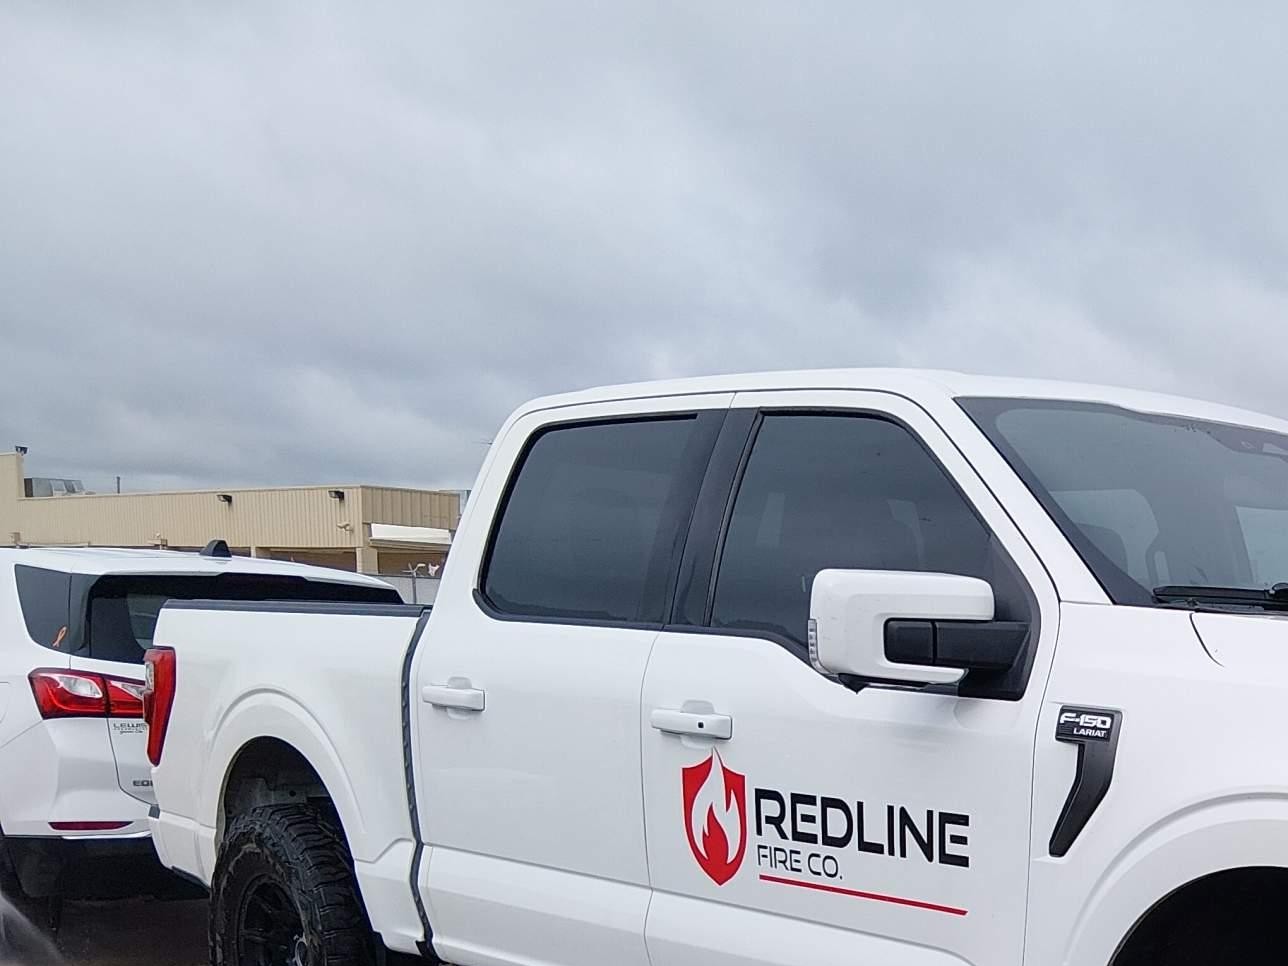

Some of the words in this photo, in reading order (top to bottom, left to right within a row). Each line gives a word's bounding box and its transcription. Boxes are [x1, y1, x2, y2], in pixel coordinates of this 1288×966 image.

[1060, 712, 1112, 729] F-150
[1073, 727, 1107, 738] LARIAT
[754, 787, 970, 868] REDLINE
[757, 844, 803, 873] FIRE
[807, 852, 843, 880] CO.
